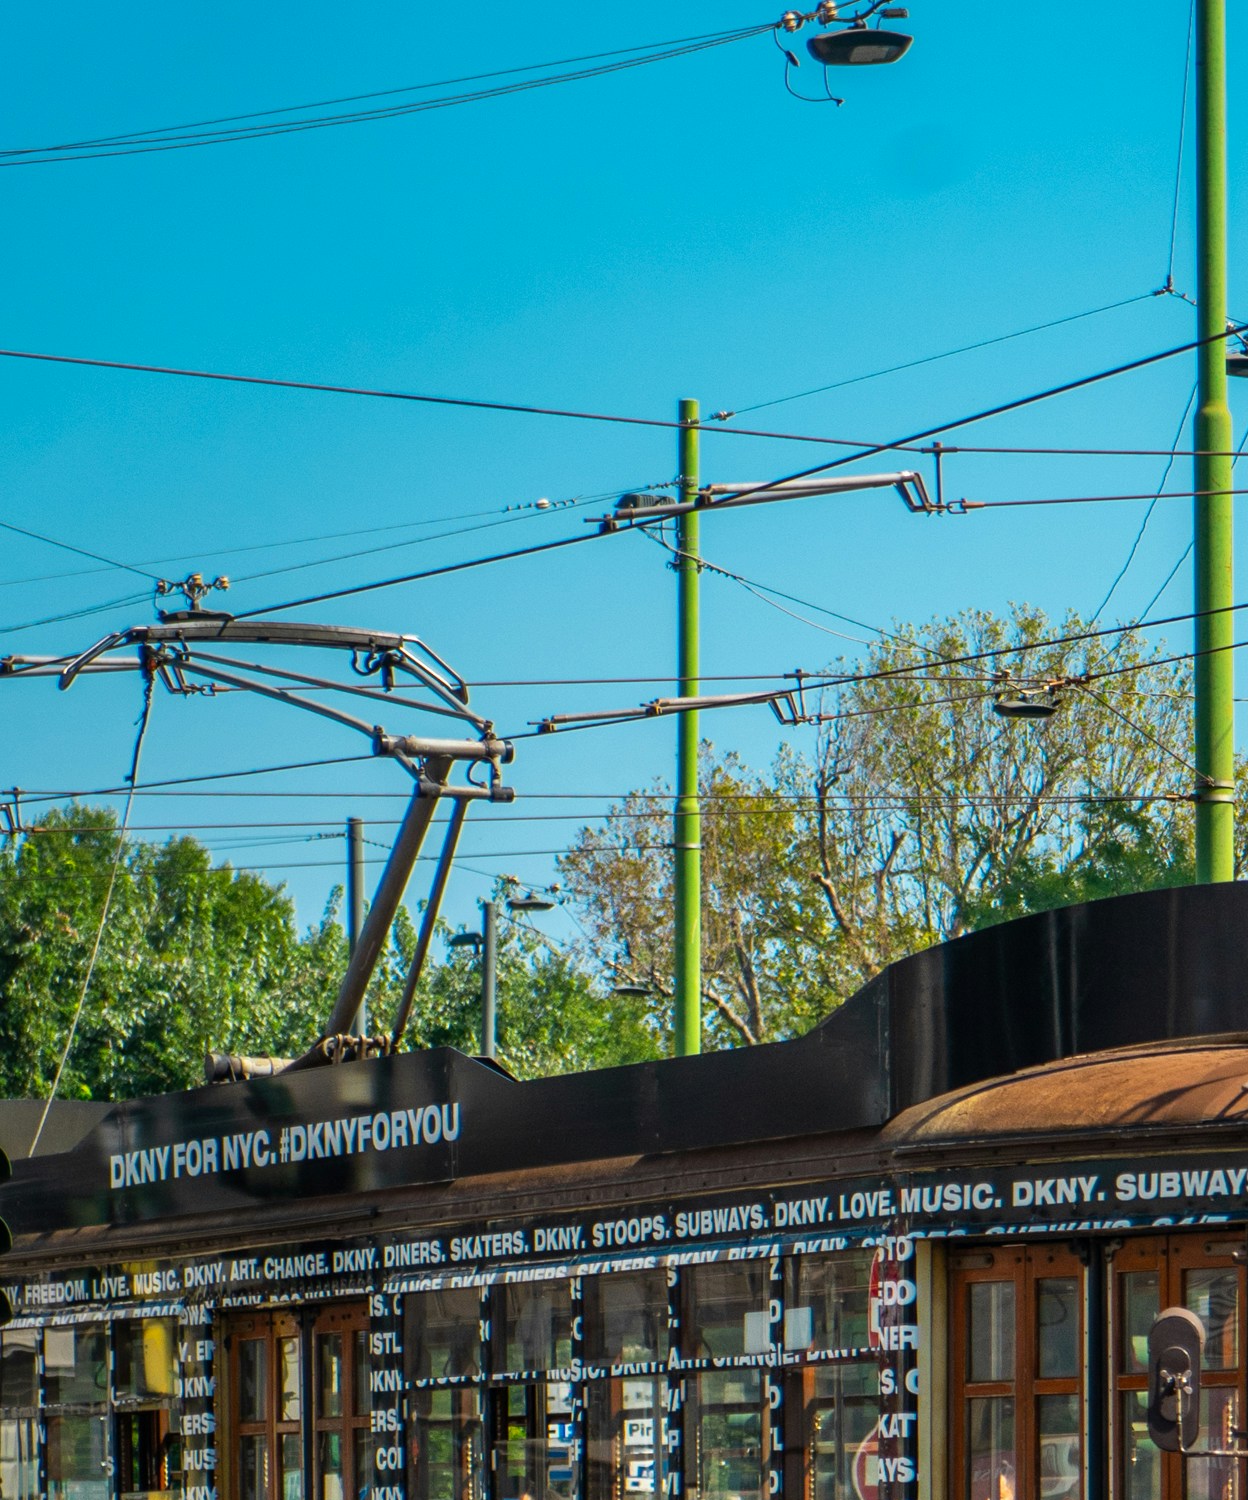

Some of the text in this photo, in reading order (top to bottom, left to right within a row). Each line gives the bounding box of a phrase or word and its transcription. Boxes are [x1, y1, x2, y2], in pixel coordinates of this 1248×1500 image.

[110, 1102, 461, 1189] DKNY FOR NYC. #DKNYFORYOU
[24, 1279, 89, 1304] FREEDOM.
[93, 1275, 131, 1299] LOVE.
[133, 1271, 181, 1295] MUSIC.
[184, 1262, 227, 1288] DKNY.
[230, 1258, 261, 1282] ART.
[264, 1252, 329, 1281] CHANGE.
[332, 1246, 380, 1274] DKNY.
[383, 1240, 446, 1269] DINERS.
[450, 1230, 528, 1263] SKATERS.
[533, 1226, 587, 1252] DKNY.
[592, 1212, 671, 1248] STOOPS.
[675, 1204, 769, 1238] SUBWAYS.
[774, 1196, 834, 1228] DKNY.
[839, 1189, 897, 1219] LOVE.
[900, 1183, 1002, 1213] MUSIC.
[1012, 1176, 1106, 1208] DKNY.
